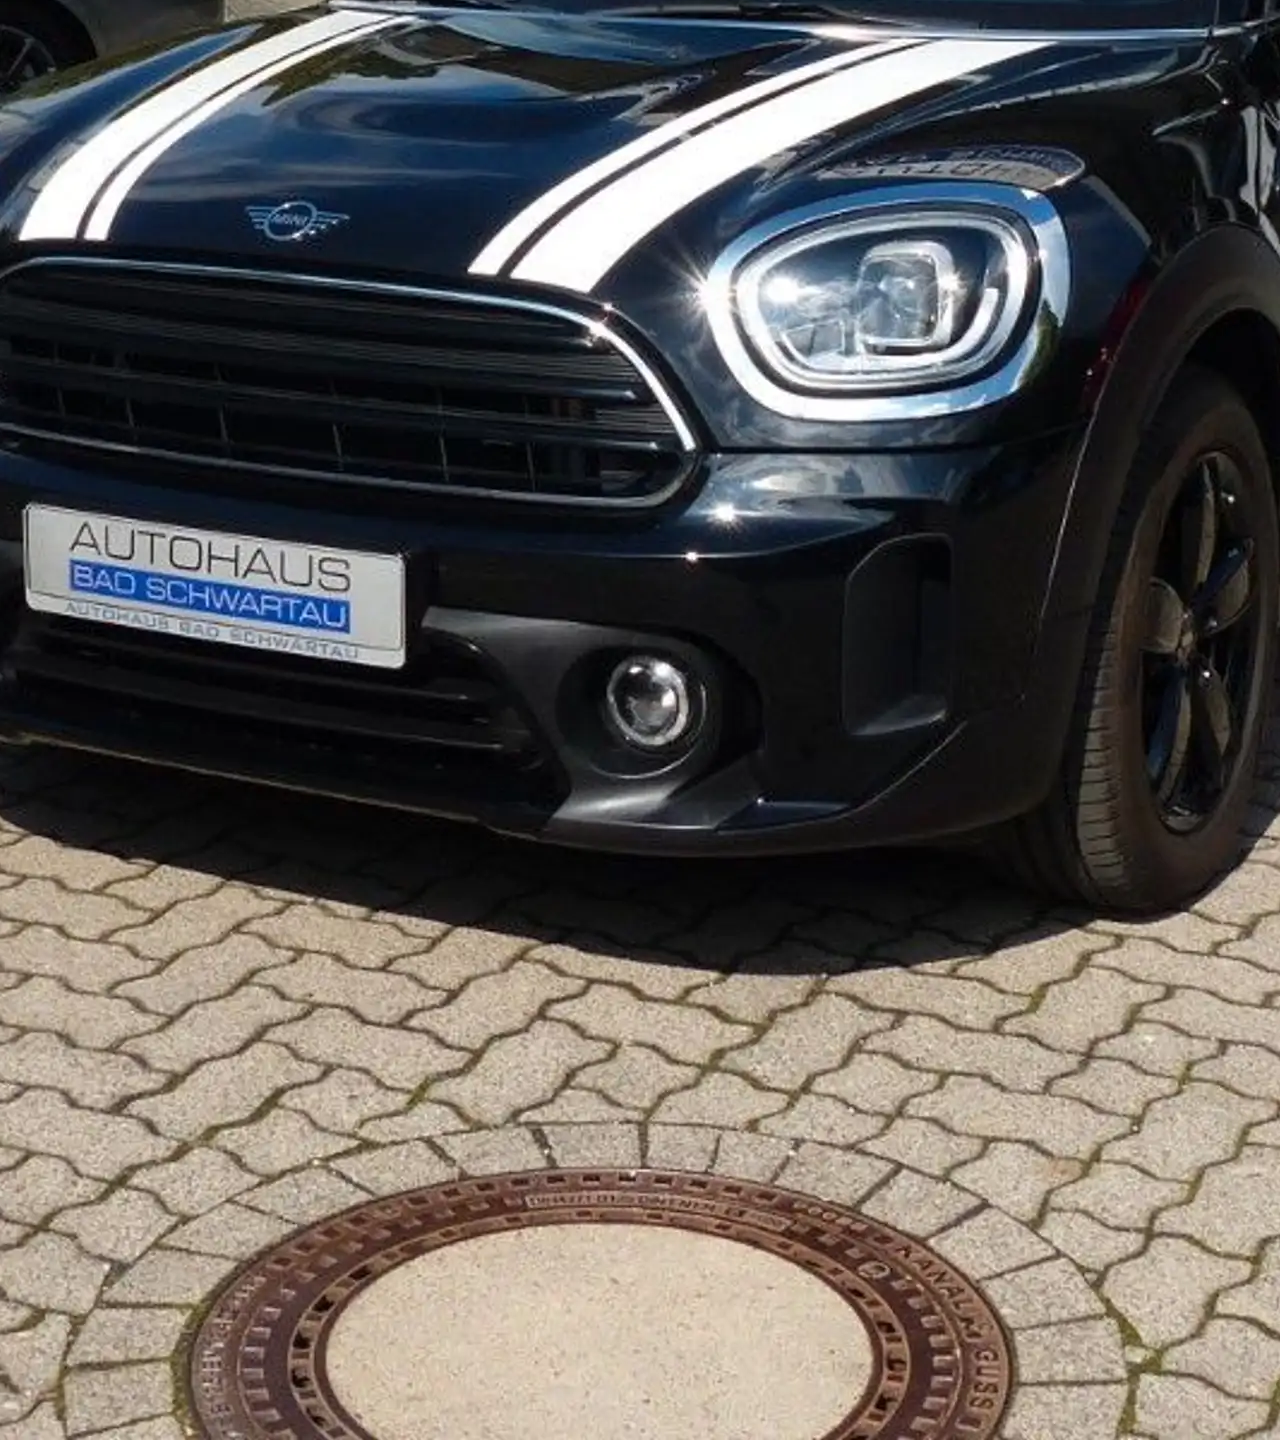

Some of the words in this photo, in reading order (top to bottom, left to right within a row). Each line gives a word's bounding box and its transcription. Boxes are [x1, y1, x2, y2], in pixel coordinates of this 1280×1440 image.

[69, 521, 351, 593] AUTOHAUS
[73, 564, 136, 596] BAD
[145, 578, 348, 628] SCHWARTAU
[63, 601, 169, 630] AUTOHAUS
[179, 621, 220, 639] BAD
[229, 629, 359, 661] SCHWARTAU
